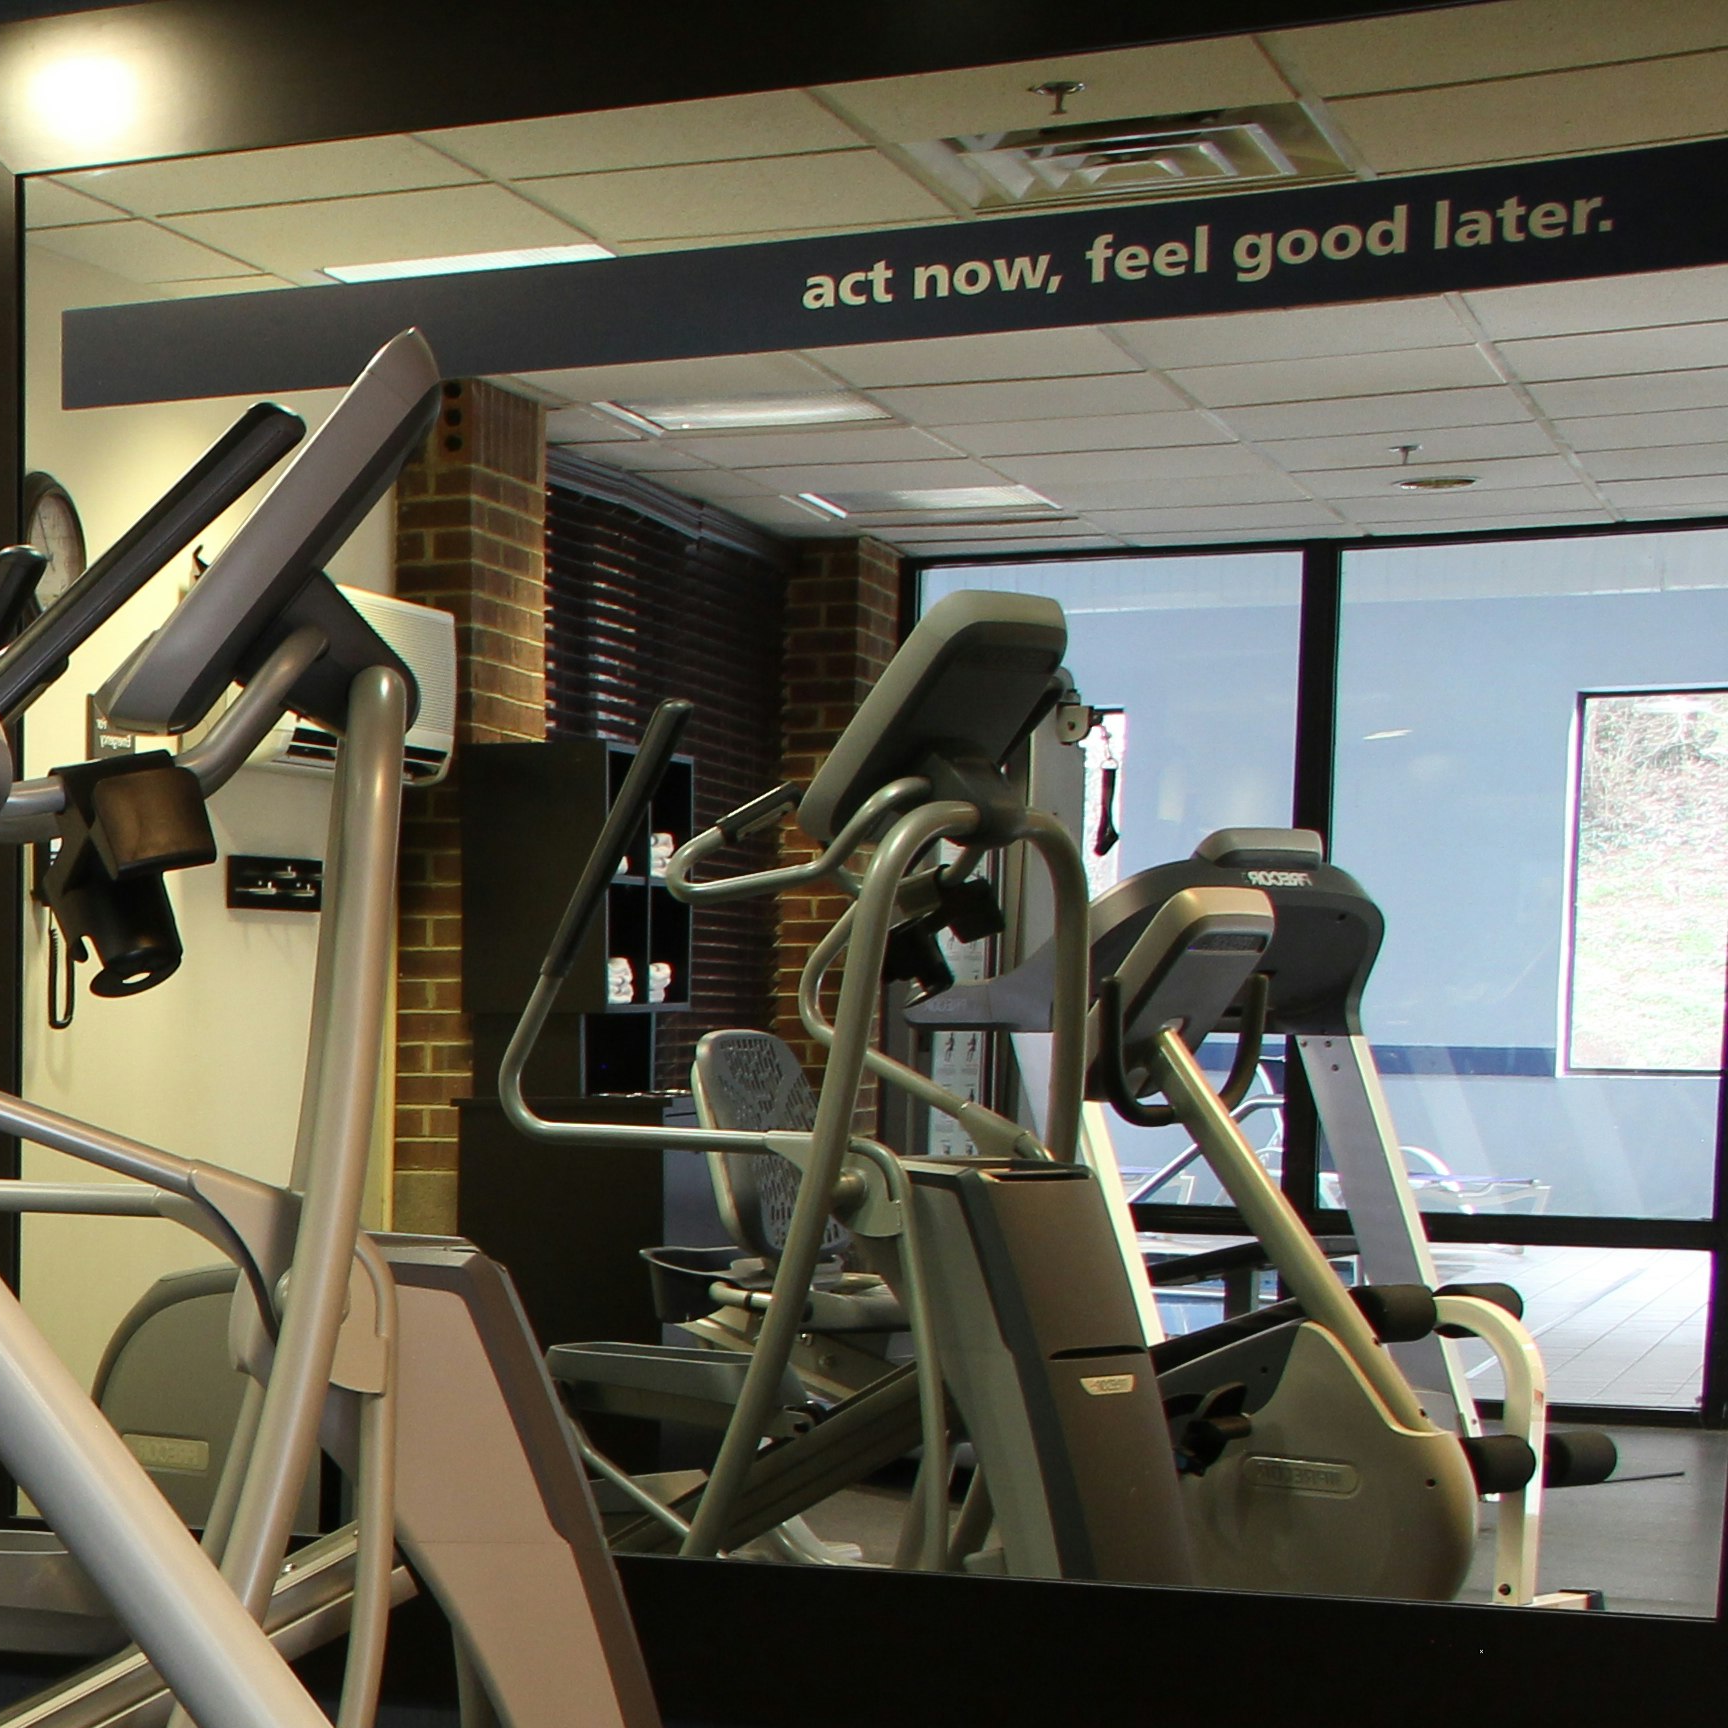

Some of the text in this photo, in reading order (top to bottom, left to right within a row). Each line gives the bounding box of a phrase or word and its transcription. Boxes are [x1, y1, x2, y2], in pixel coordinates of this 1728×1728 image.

[802, 194, 1613, 309] act now, feel good later.
